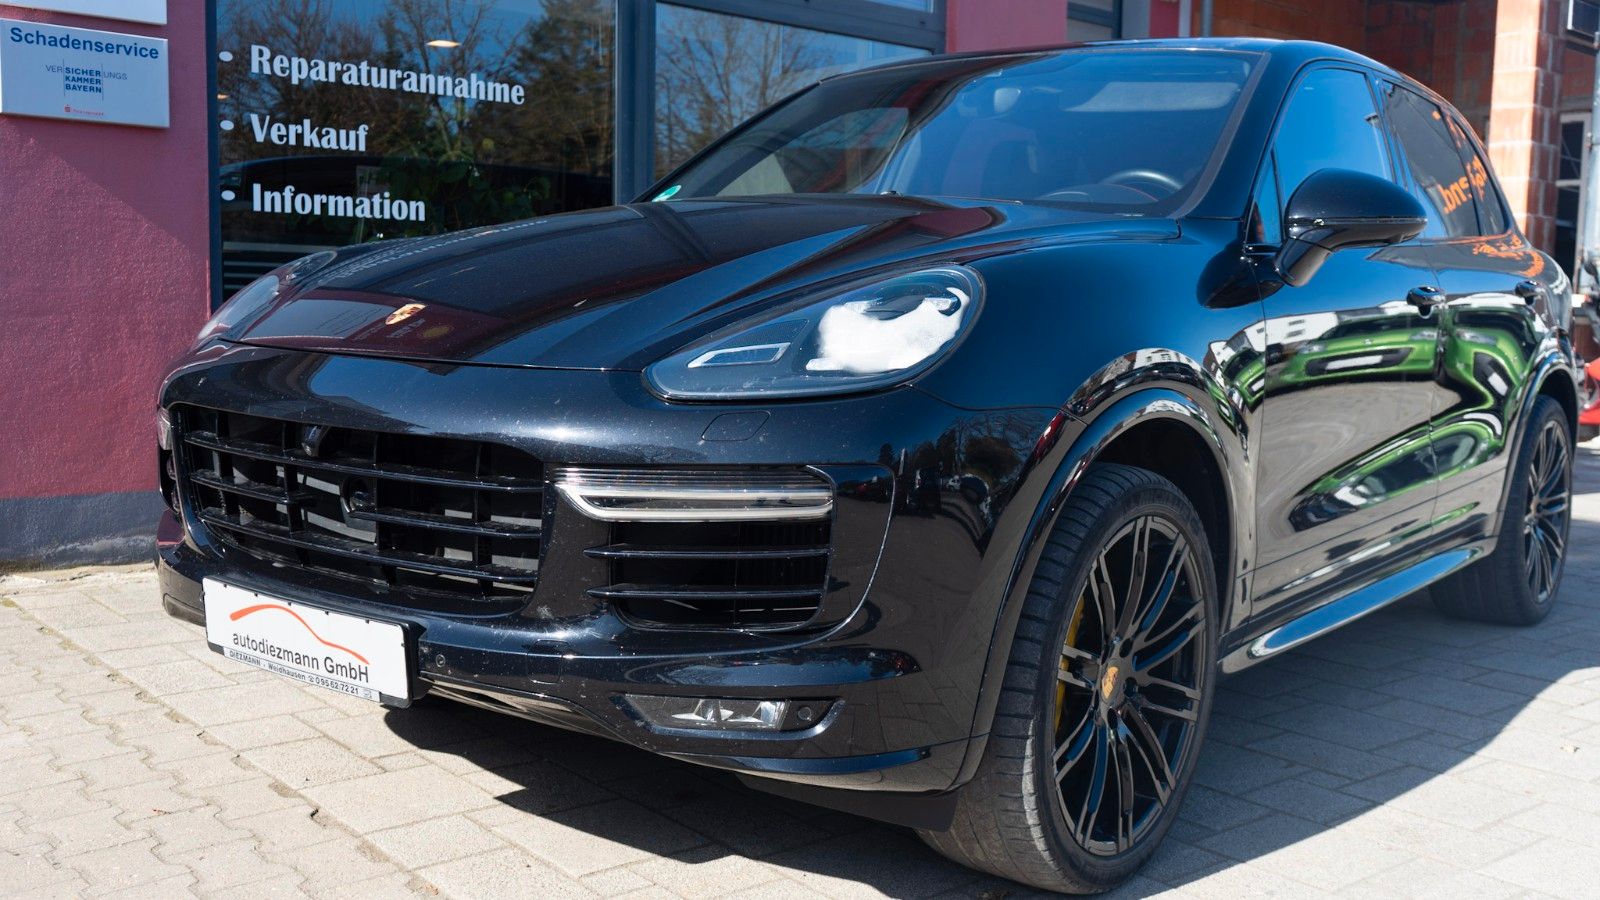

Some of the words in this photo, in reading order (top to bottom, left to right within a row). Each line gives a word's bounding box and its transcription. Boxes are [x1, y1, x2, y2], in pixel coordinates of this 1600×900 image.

[10, 27, 159, 59] Schadenservice
[65, 75, 102, 85] KAMMER
[65, 83, 102, 93] BAYERN
[250, 44, 525, 105] Reparaturannahme
[250, 113, 369, 151] Verkauf
[252, 182, 426, 222] Information
[229, 650, 261, 666] DIEZMANN
[267, 663, 306, 680] Weidhausen
[232, 632, 320, 670] autodiezmann
[323, 656, 369, 684] GmbH
